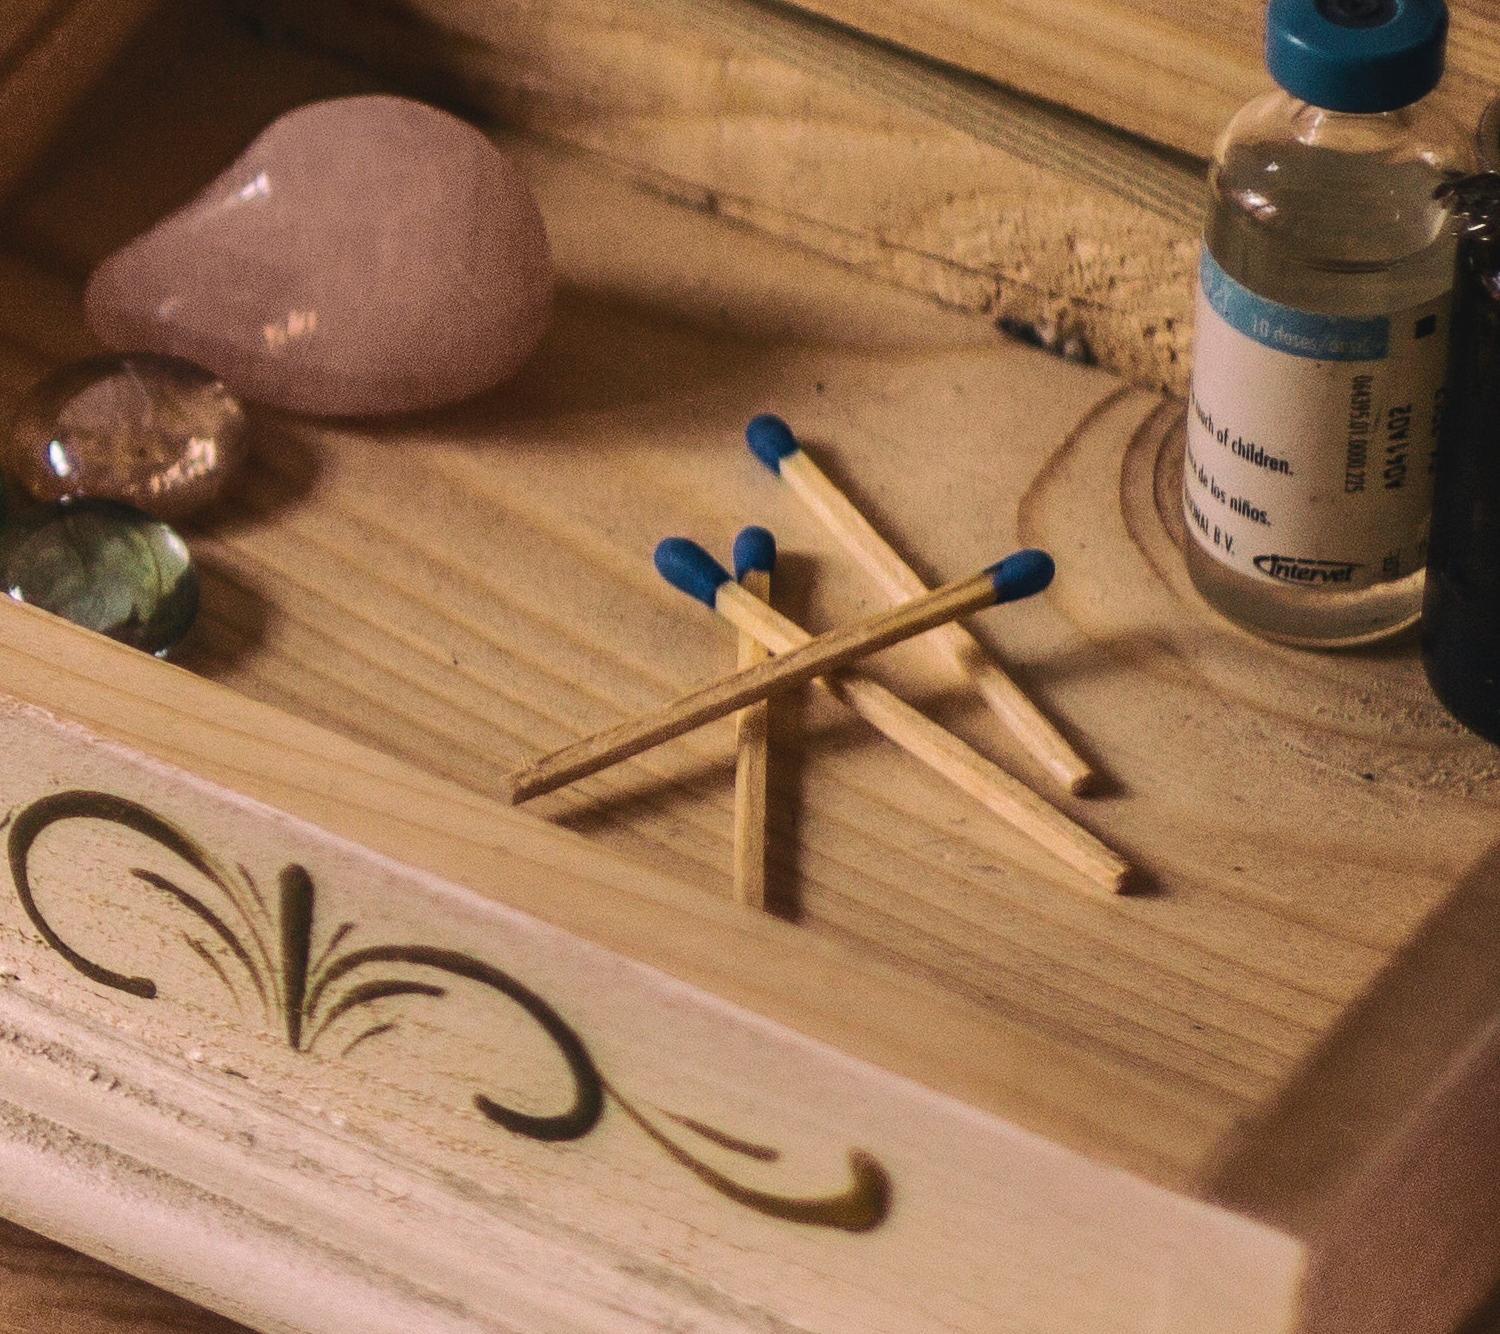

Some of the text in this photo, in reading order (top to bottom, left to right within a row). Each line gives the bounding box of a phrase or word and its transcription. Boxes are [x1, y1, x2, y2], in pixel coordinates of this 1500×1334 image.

[1217, 428, 1228, 446] of
[1231, 437, 1294, 477] children.
[1211, 476, 1226, 505] los
[1230, 494, 1272, 526] niños.
